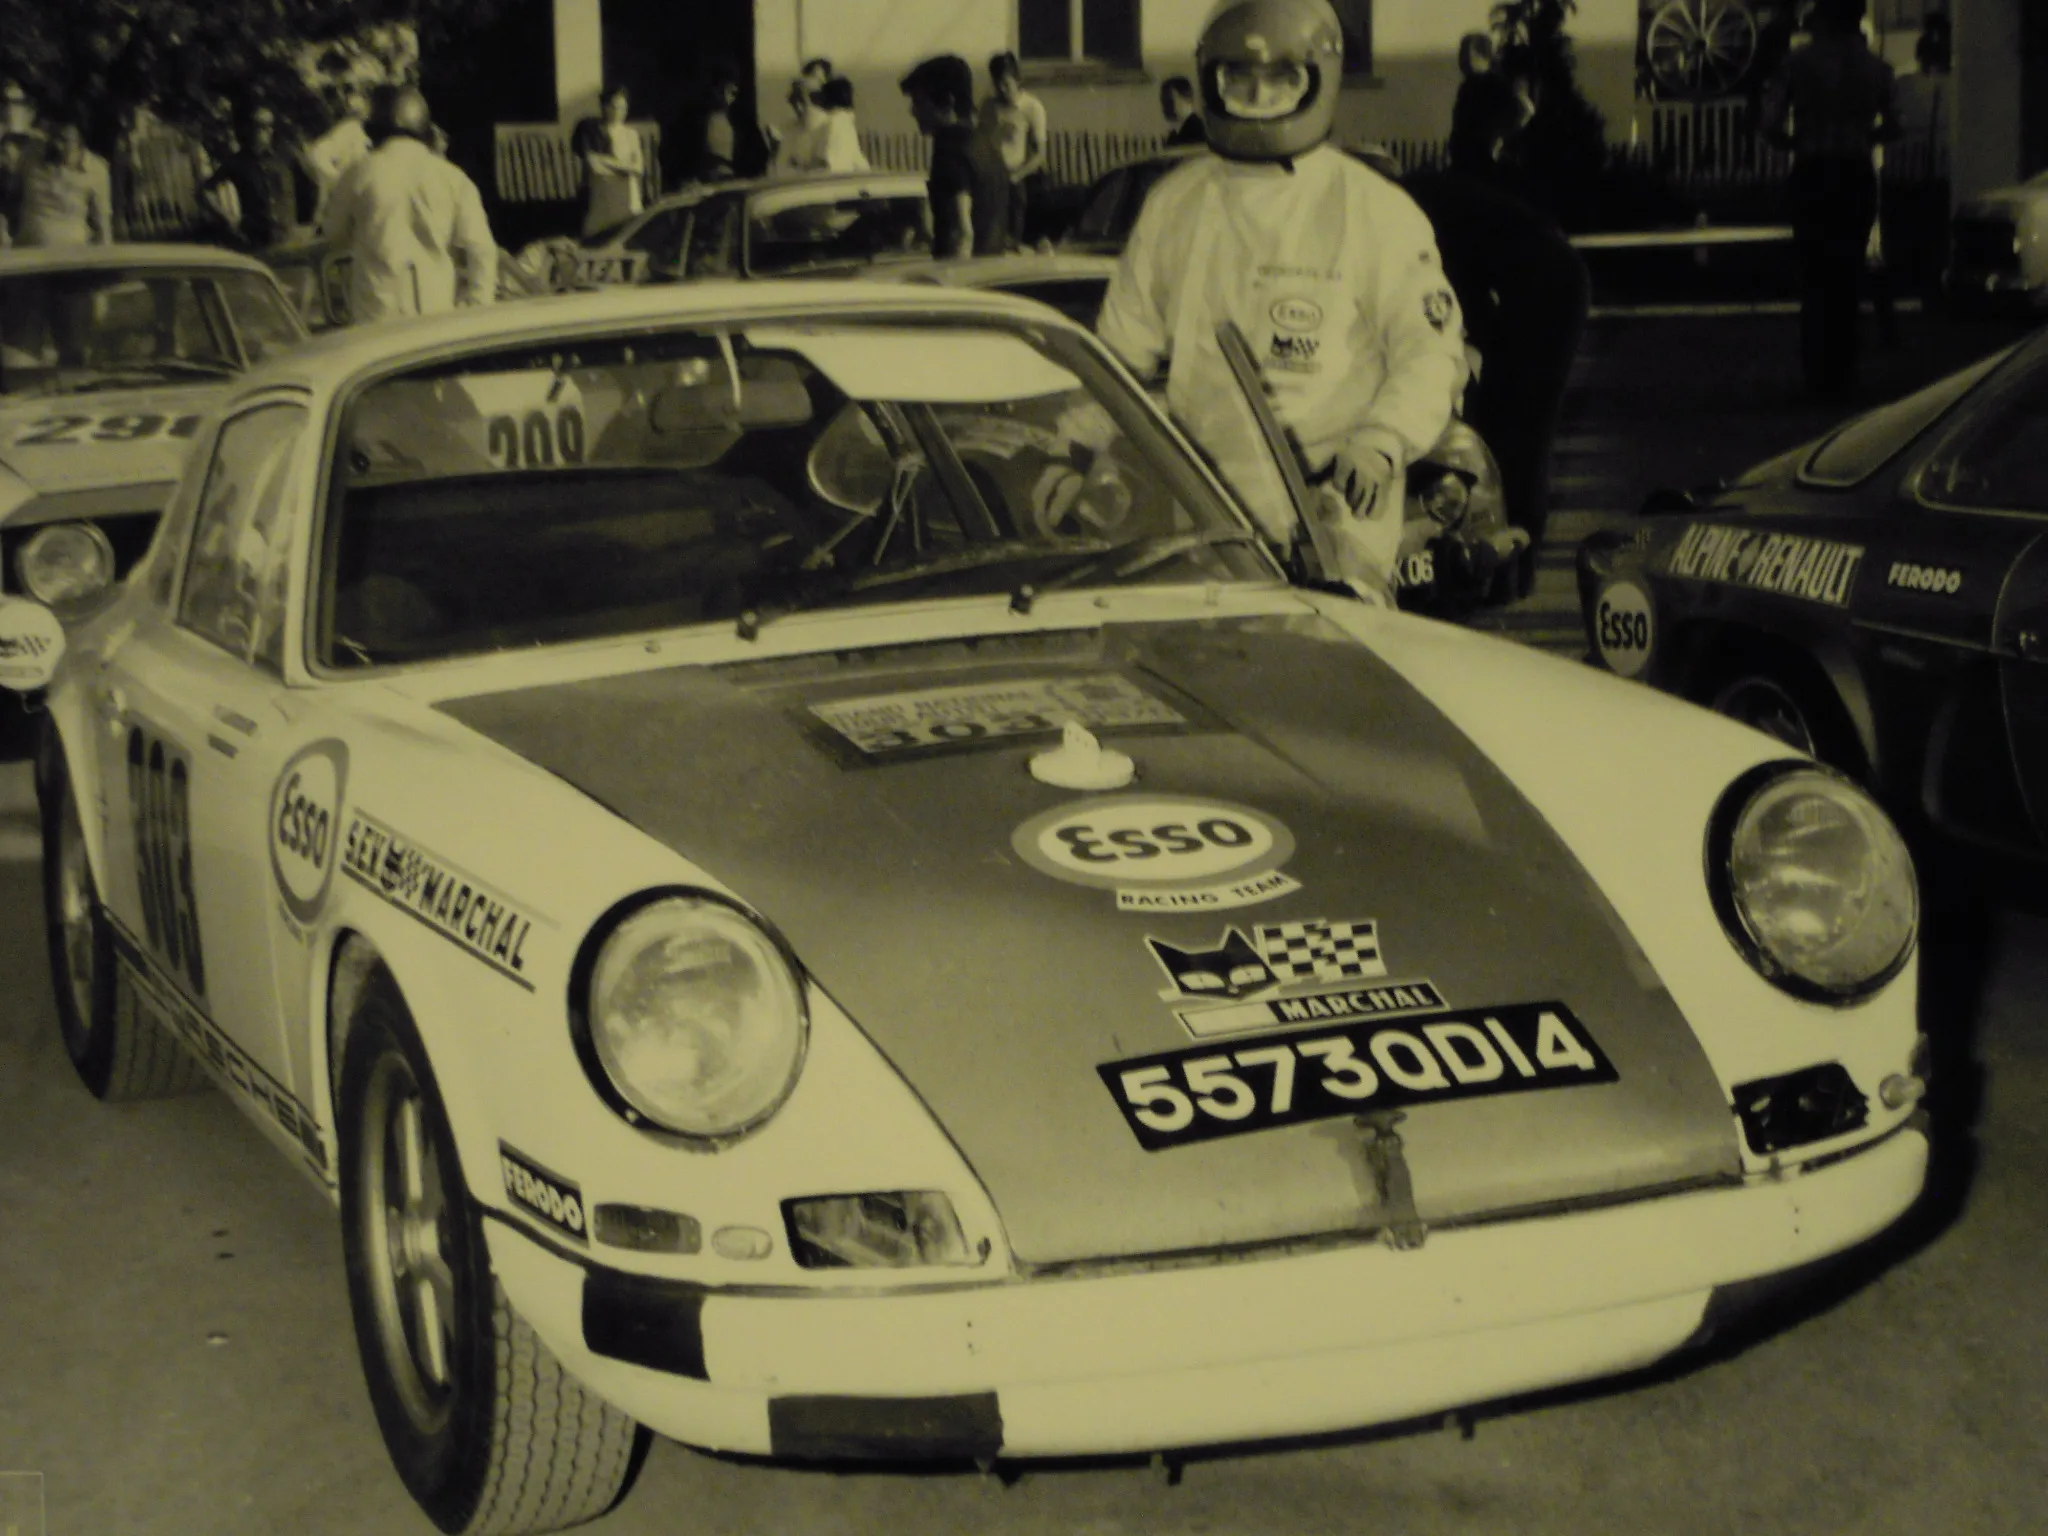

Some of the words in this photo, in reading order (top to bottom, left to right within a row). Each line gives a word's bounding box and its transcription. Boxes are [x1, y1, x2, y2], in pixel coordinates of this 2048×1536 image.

[1668, 522, 1750, 581] ALPINE
[1747, 531, 1866, 604] RENAULT
[1888, 562, 1962, 594] FERODO
[344, 818, 386, 878] SEV
[418, 867, 531, 972] MARCHAL
[1120, 893, 1219, 907] RACING
[1231, 875, 1289, 899] TEAM
[1280, 984, 1434, 1021] MARCHAL
[501, 1155, 583, 1232] FERODO
